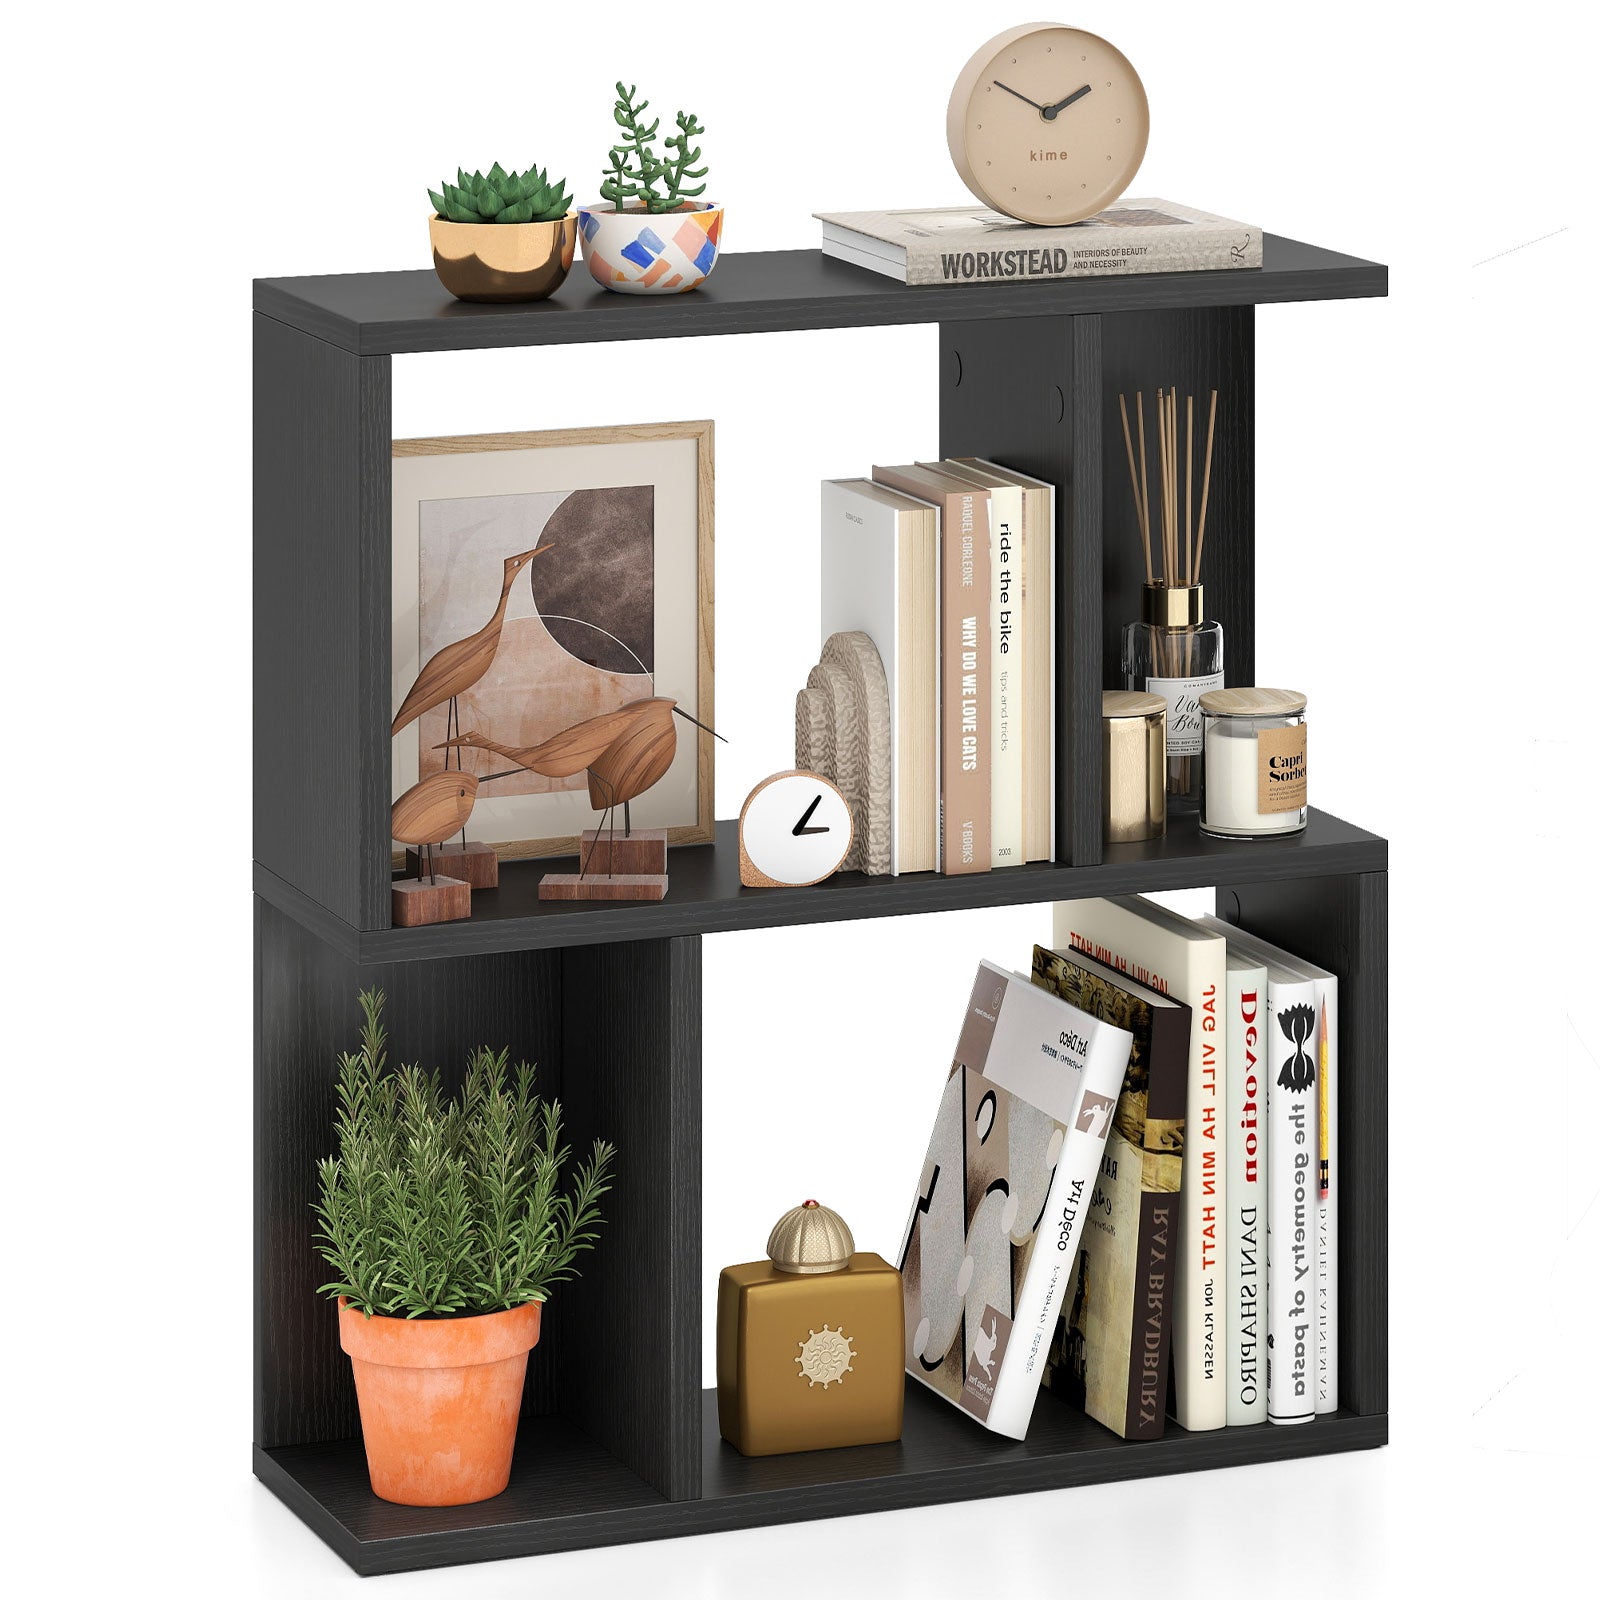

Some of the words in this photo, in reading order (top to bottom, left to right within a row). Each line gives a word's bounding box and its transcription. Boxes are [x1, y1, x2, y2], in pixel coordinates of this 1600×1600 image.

[1029, 149, 1069, 161] kime
[940, 247, 1067, 279] WORKSTEAD
[1073, 249, 1109, 259] INTERIORS
[1110, 248, 1121, 257] OF
[1121, 246, 1148, 256] BEAUTY
[1073, 260, 1088, 270] AND
[1089, 258, 1127, 269] NECESSITY
[1000, 523, 1011, 563] ride
[962, 536, 973, 587] CORLEONE
[1000, 569, 1011, 604] the
[962, 616, 977, 648] WHY
[1000, 611, 1011, 654] bike
[962, 651, 977, 671] DO
[962, 673, 977, 695] WE
[1000, 671, 1008, 692] tips
[962, 699, 977, 732] LOVE
[1000, 695, 1008, 719] and
[1000, 721, 1008, 751] tricks
[962, 736, 977, 771] CATS
[1269, 752, 1303, 770] Capri
[998, 847, 1011, 857] 2003
